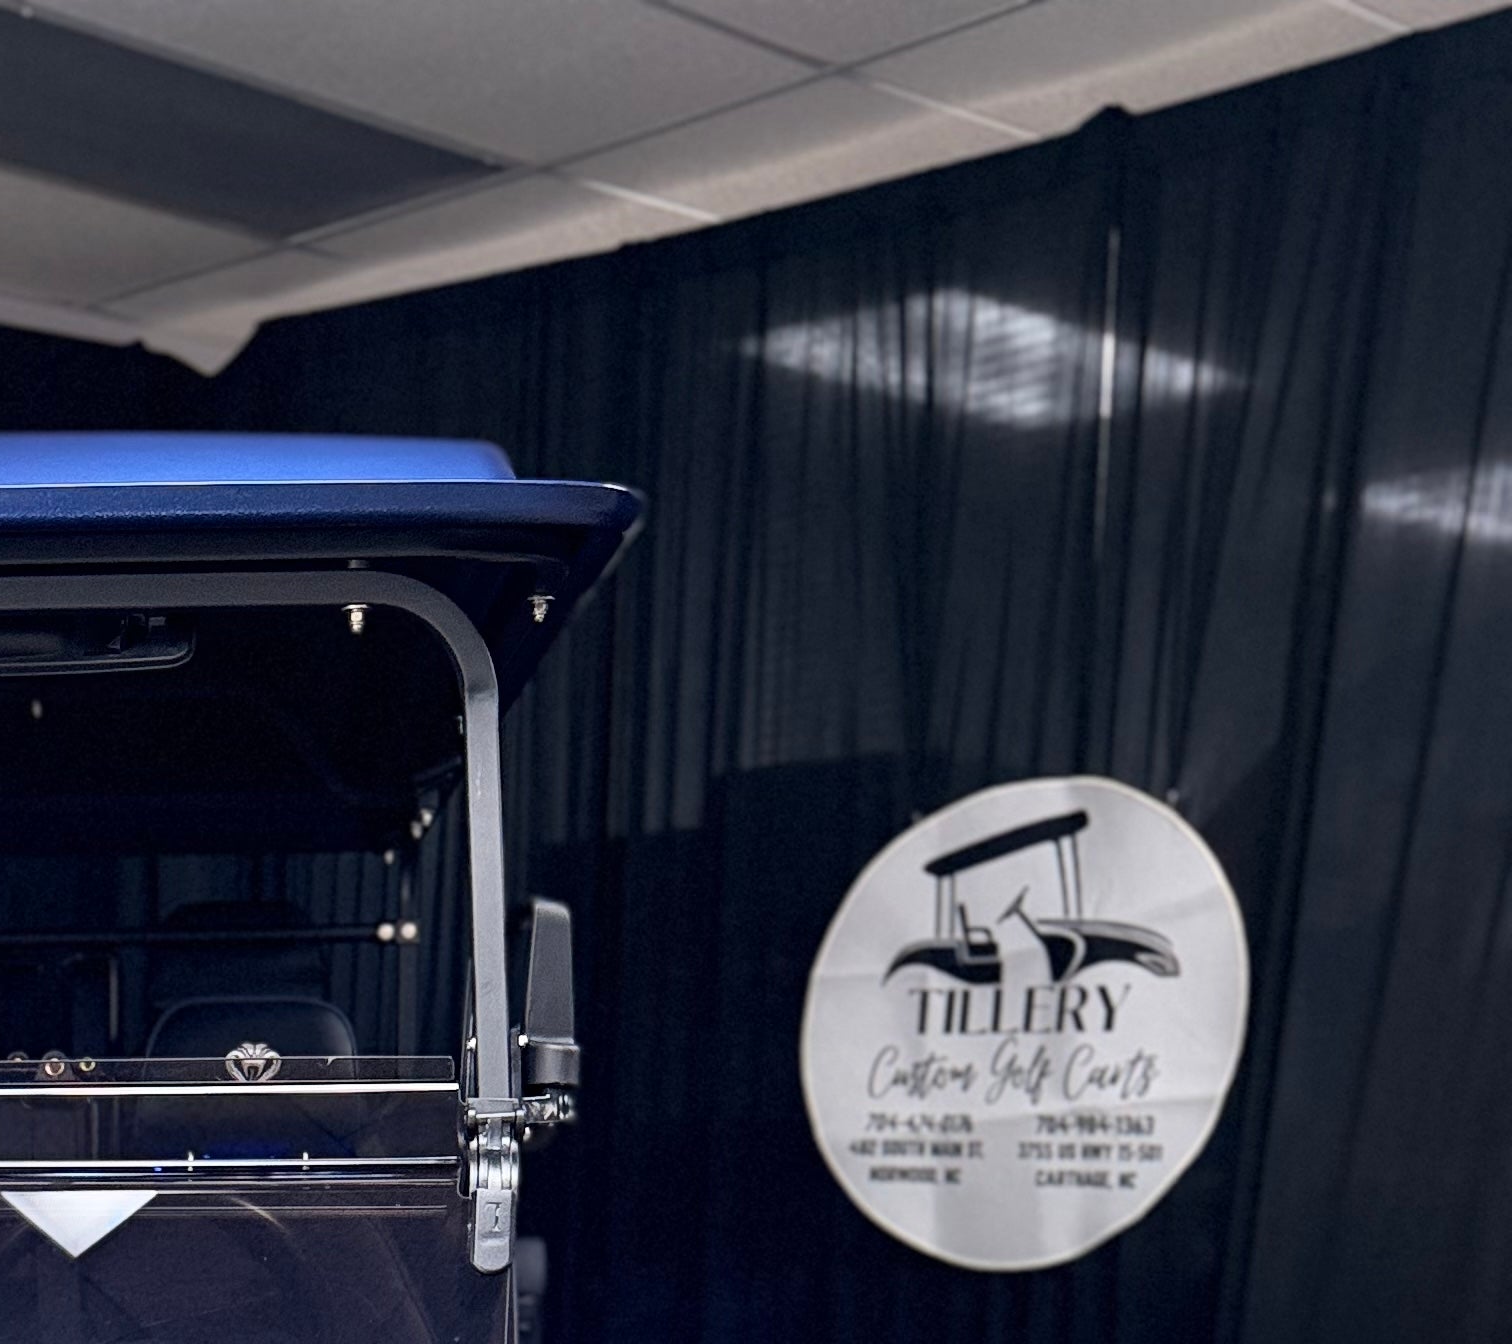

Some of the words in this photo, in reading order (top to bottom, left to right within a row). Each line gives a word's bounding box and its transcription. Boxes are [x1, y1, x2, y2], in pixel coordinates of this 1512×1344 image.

[910, 985, 1131, 1035] TILLERY
[867, 1044, 977, 1101] Custom
[984, 1034, 1052, 1105] Golf
[1062, 1044, 1160, 1101] Carts
